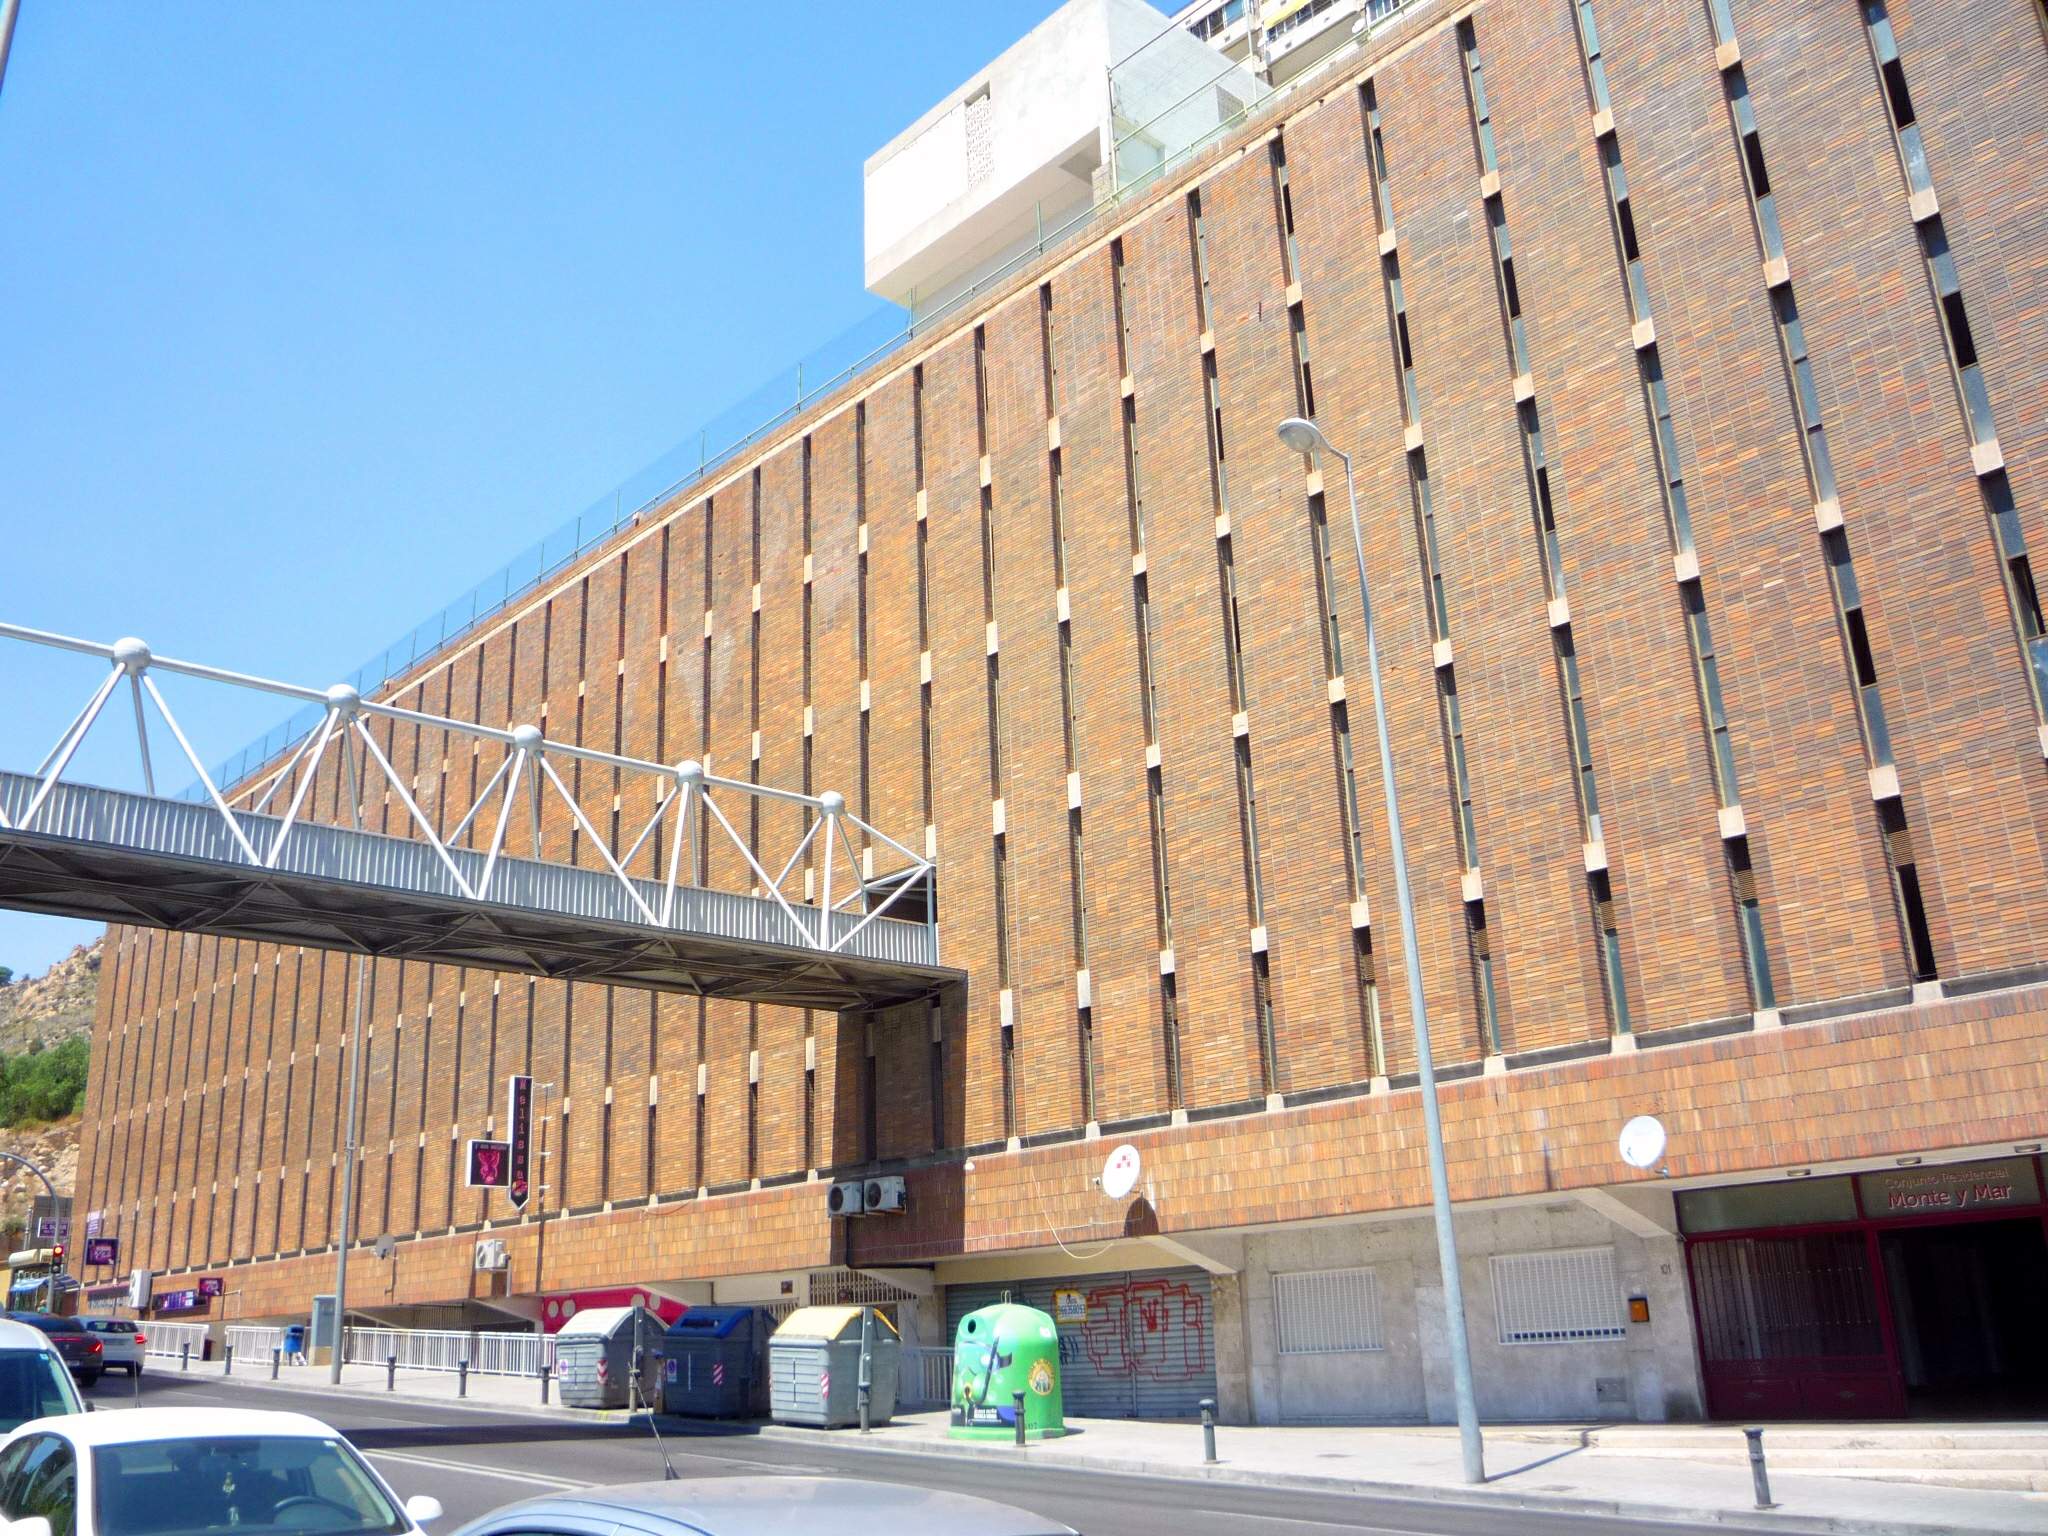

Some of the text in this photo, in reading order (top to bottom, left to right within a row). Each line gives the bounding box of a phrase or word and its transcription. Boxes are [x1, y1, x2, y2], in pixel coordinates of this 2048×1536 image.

[516, 1079, 527, 1179] Melissa
[1885, 1167, 2009, 1189] Conjunto Residencial
[1888, 1184, 2012, 1209] Monte y Mar
